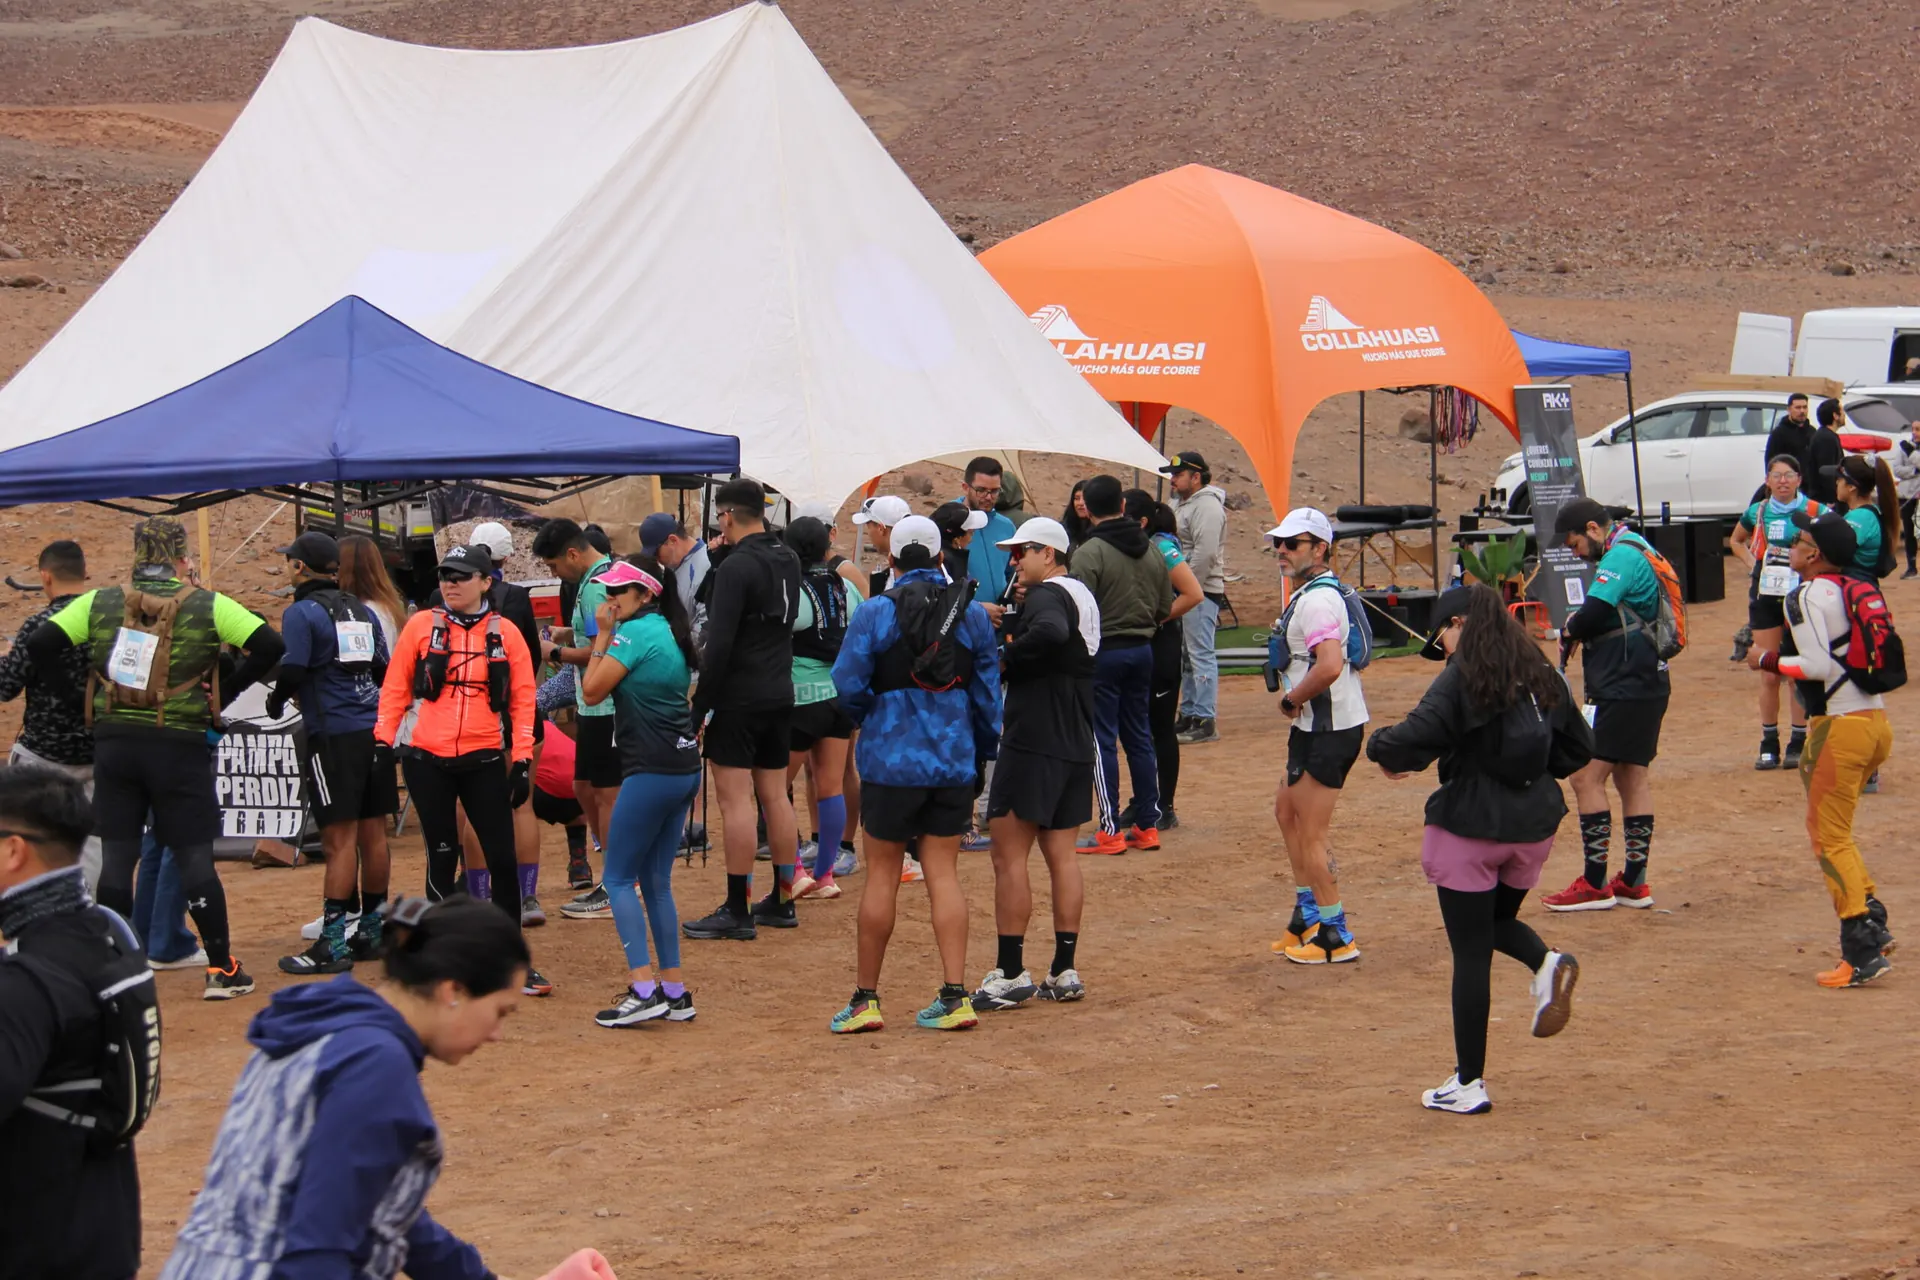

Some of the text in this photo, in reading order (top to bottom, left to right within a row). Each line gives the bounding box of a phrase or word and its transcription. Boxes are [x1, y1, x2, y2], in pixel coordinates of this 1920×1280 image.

[1301, 326, 1440, 351] COLLAHUASI
[1056, 342, 1206, 360] LAHUASI
[1362, 347, 1447, 362] MUCHO MÁS QUE COBRE
[1110, 363, 1134, 375] MÁS
[1137, 365, 1160, 375] QUE
[1162, 365, 1201, 375] COBRE
[1773, 577, 1784, 587] 12
[354, 635, 367, 650] 94
[121, 647, 138, 668] 56
[217, 733, 300, 775] PAMPA
[216, 776, 301, 807] PERDIZ
